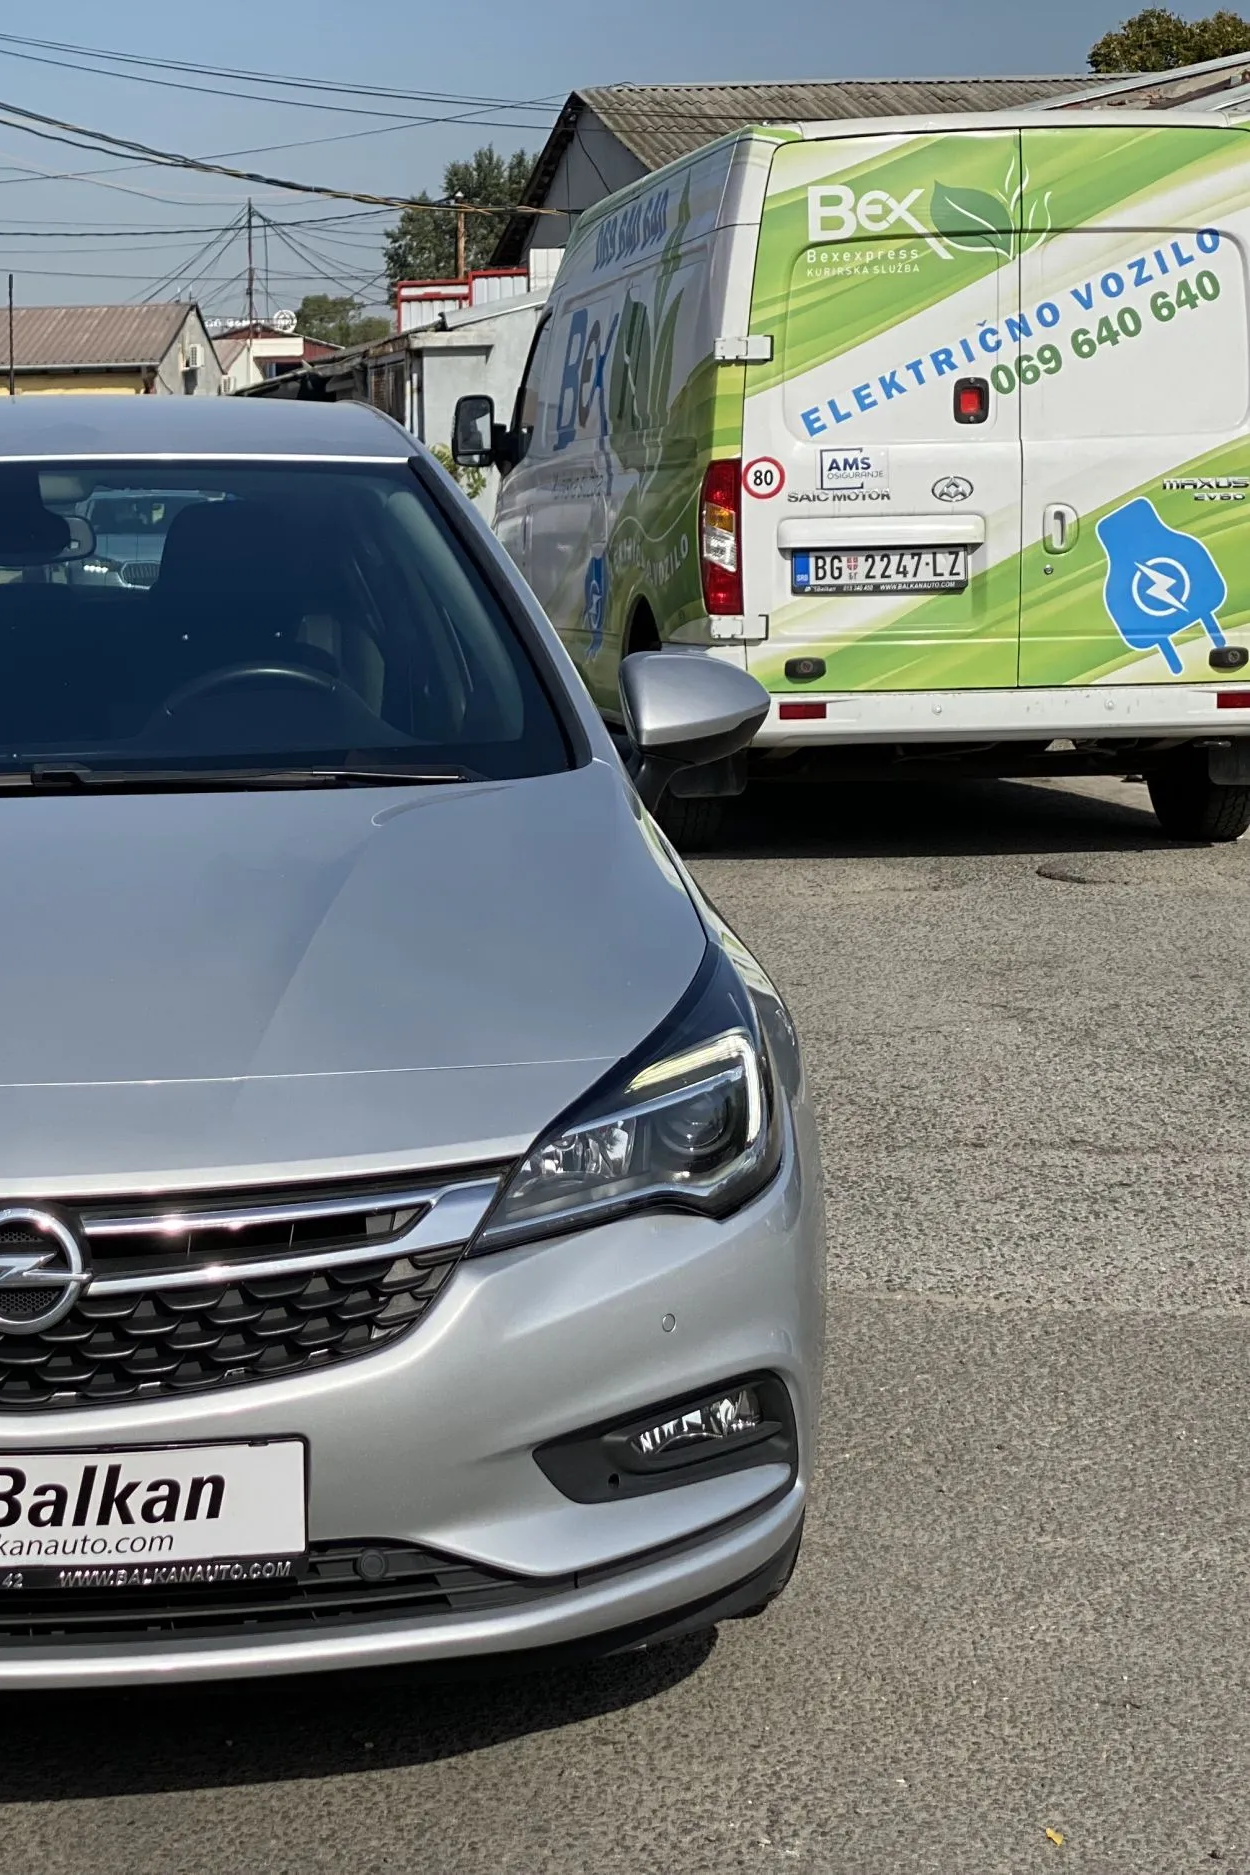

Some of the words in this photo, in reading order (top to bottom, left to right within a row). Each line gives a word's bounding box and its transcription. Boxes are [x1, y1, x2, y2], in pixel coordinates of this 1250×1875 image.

[806, 249, 919, 264] Bexexpress
[806, 266, 870, 278] KURIRSKA
[872, 262, 920, 275] SLUŽBA
[800, 301, 1061, 438] ELEKTRIČNO
[1070, 227, 1220, 311] VOZILO
[990, 343, 1063, 395] 069
[1070, 306, 1142, 359] 640
[1150, 269, 1222, 322] 640
[827, 457, 872, 472] AMS
[753, 469, 774, 486] 80
[826, 470, 884, 480] OSIGURANJE
[1162, 477, 1250, 490] MAXUS
[787, 491, 829, 503] SAIC
[832, 489, 891, 502] MOTOR
[814, 555, 843, 581] BG
[1, 1573, 24, 1588] 42
[59, 1561, 292, 1588] WWW.BALKANAUTO.COM
